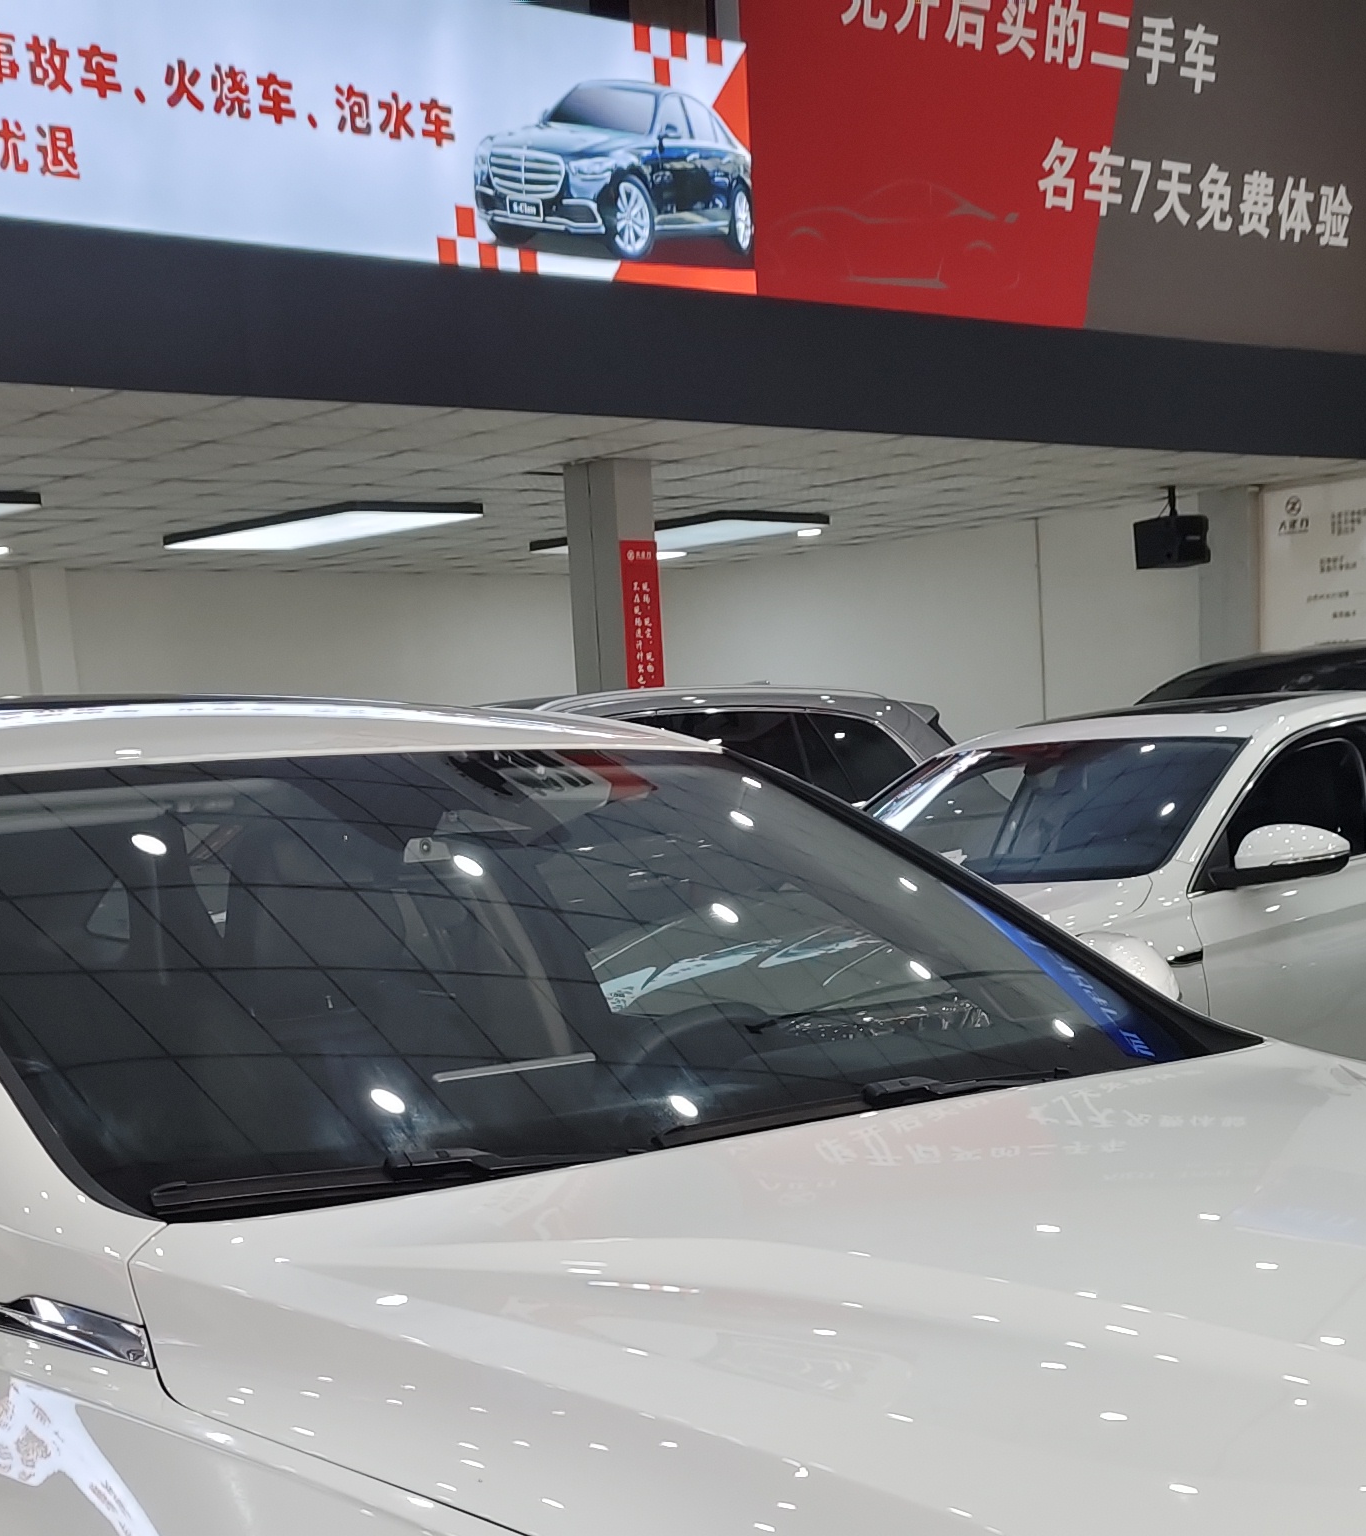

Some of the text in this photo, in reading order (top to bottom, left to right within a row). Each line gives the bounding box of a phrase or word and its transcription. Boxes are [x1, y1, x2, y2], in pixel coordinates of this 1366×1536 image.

[1036, 136, 1355, 250] 名车7天免费体验
